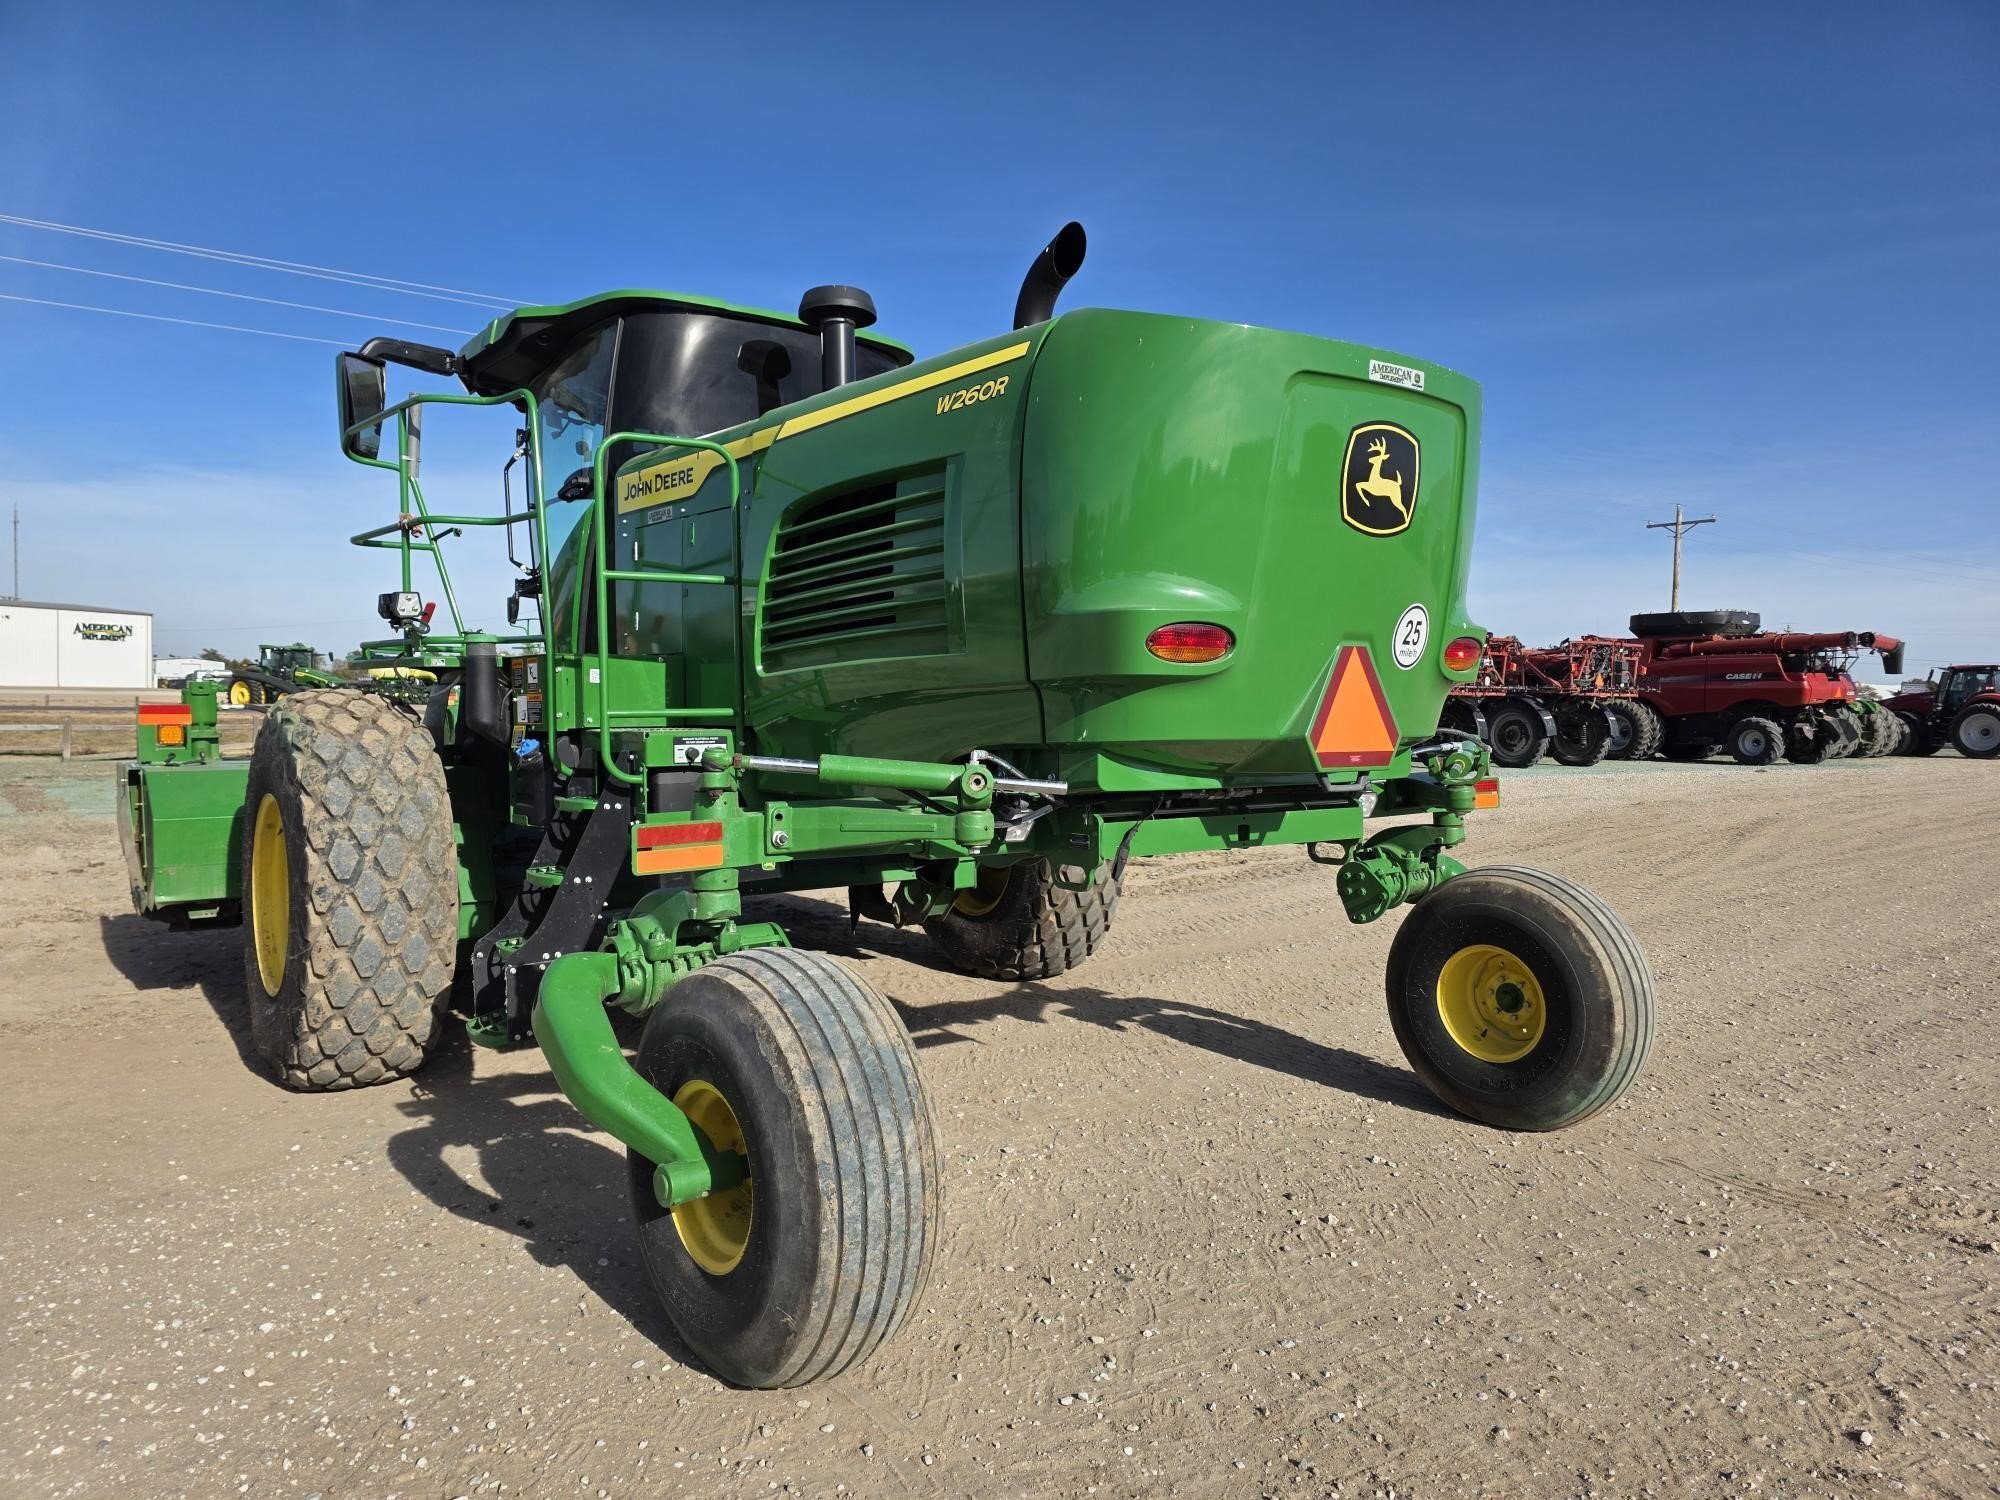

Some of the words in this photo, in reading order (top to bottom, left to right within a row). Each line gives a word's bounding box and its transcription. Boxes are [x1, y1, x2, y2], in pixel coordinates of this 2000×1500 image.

[1371, 363, 1412, 382] AMERICAN
[936, 375, 1010, 415] W260R
[624, 480, 652, 501] JOHN
[654, 467, 694, 493] DEERE
[73, 623, 133, 636] AMERICAN
[1402, 619, 1422, 646] 25
